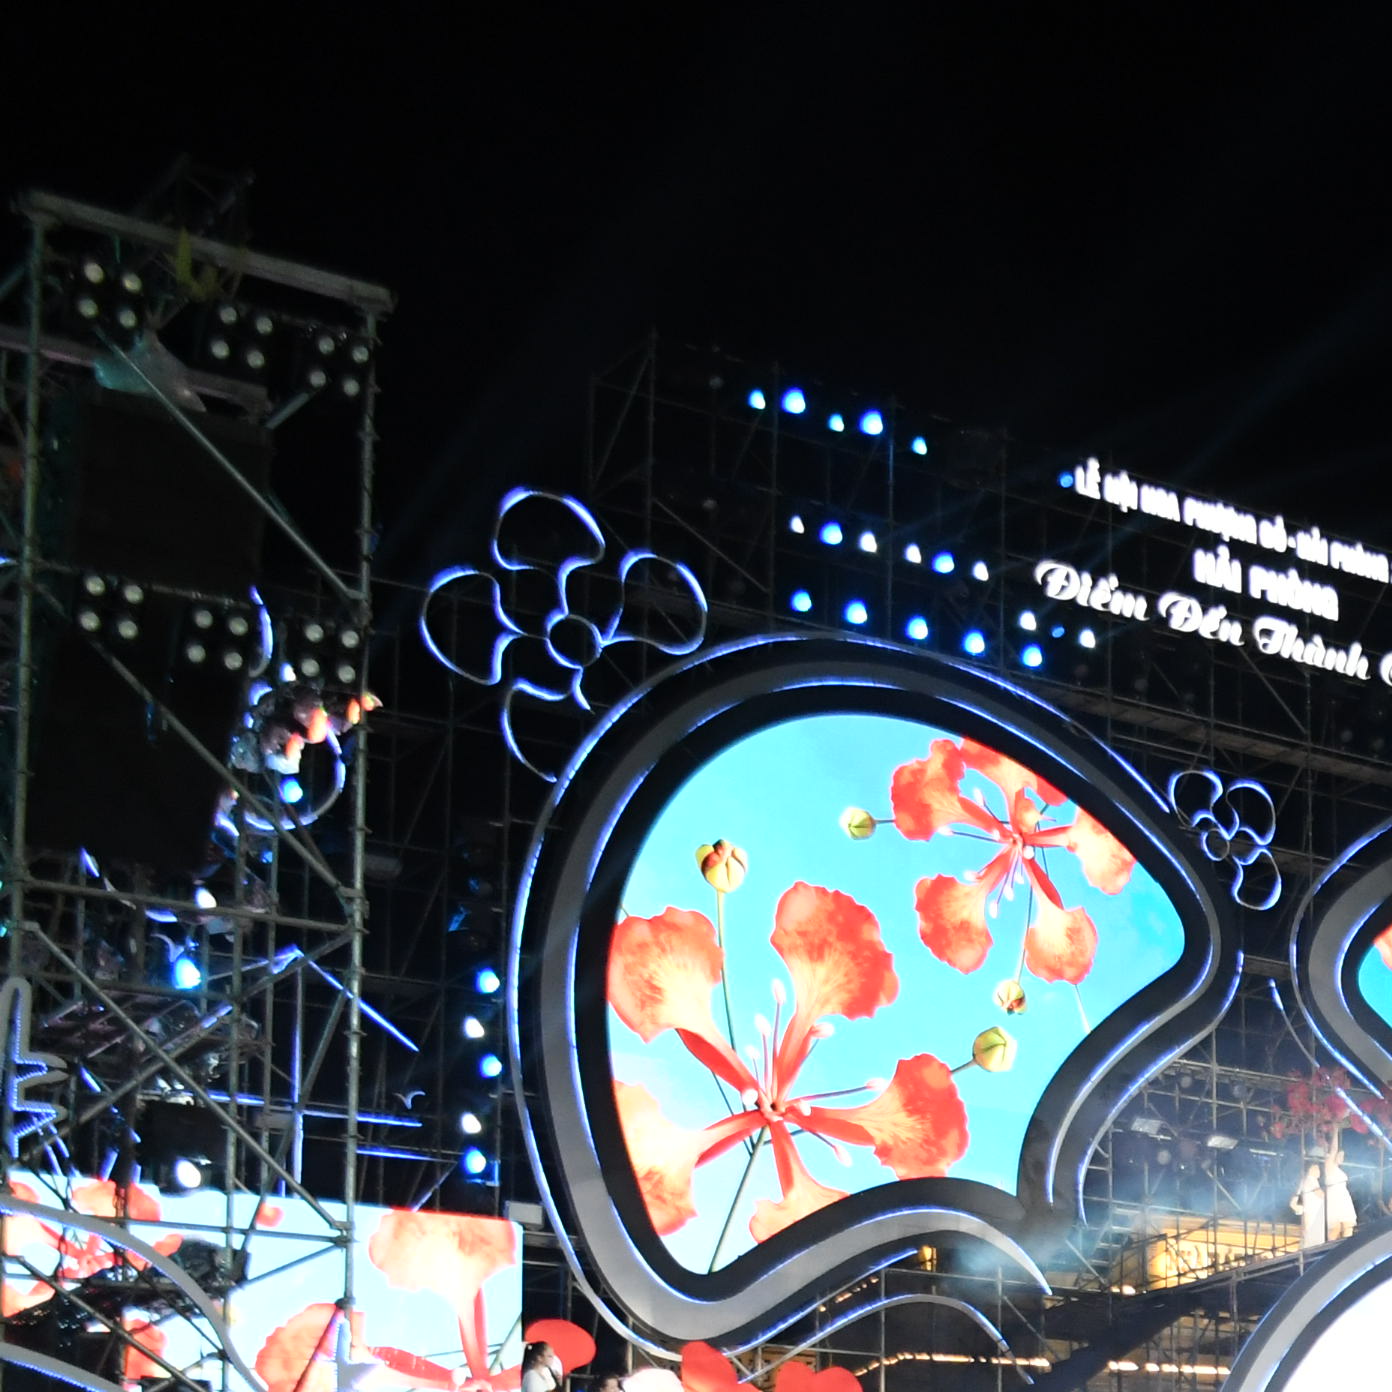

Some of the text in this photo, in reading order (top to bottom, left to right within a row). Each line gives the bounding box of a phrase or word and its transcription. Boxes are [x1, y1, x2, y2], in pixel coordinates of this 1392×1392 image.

[1035, 559, 1149, 621] Điểm
[1158, 591, 1244, 646] Đến
[1253, 615, 1371, 680] Thành
